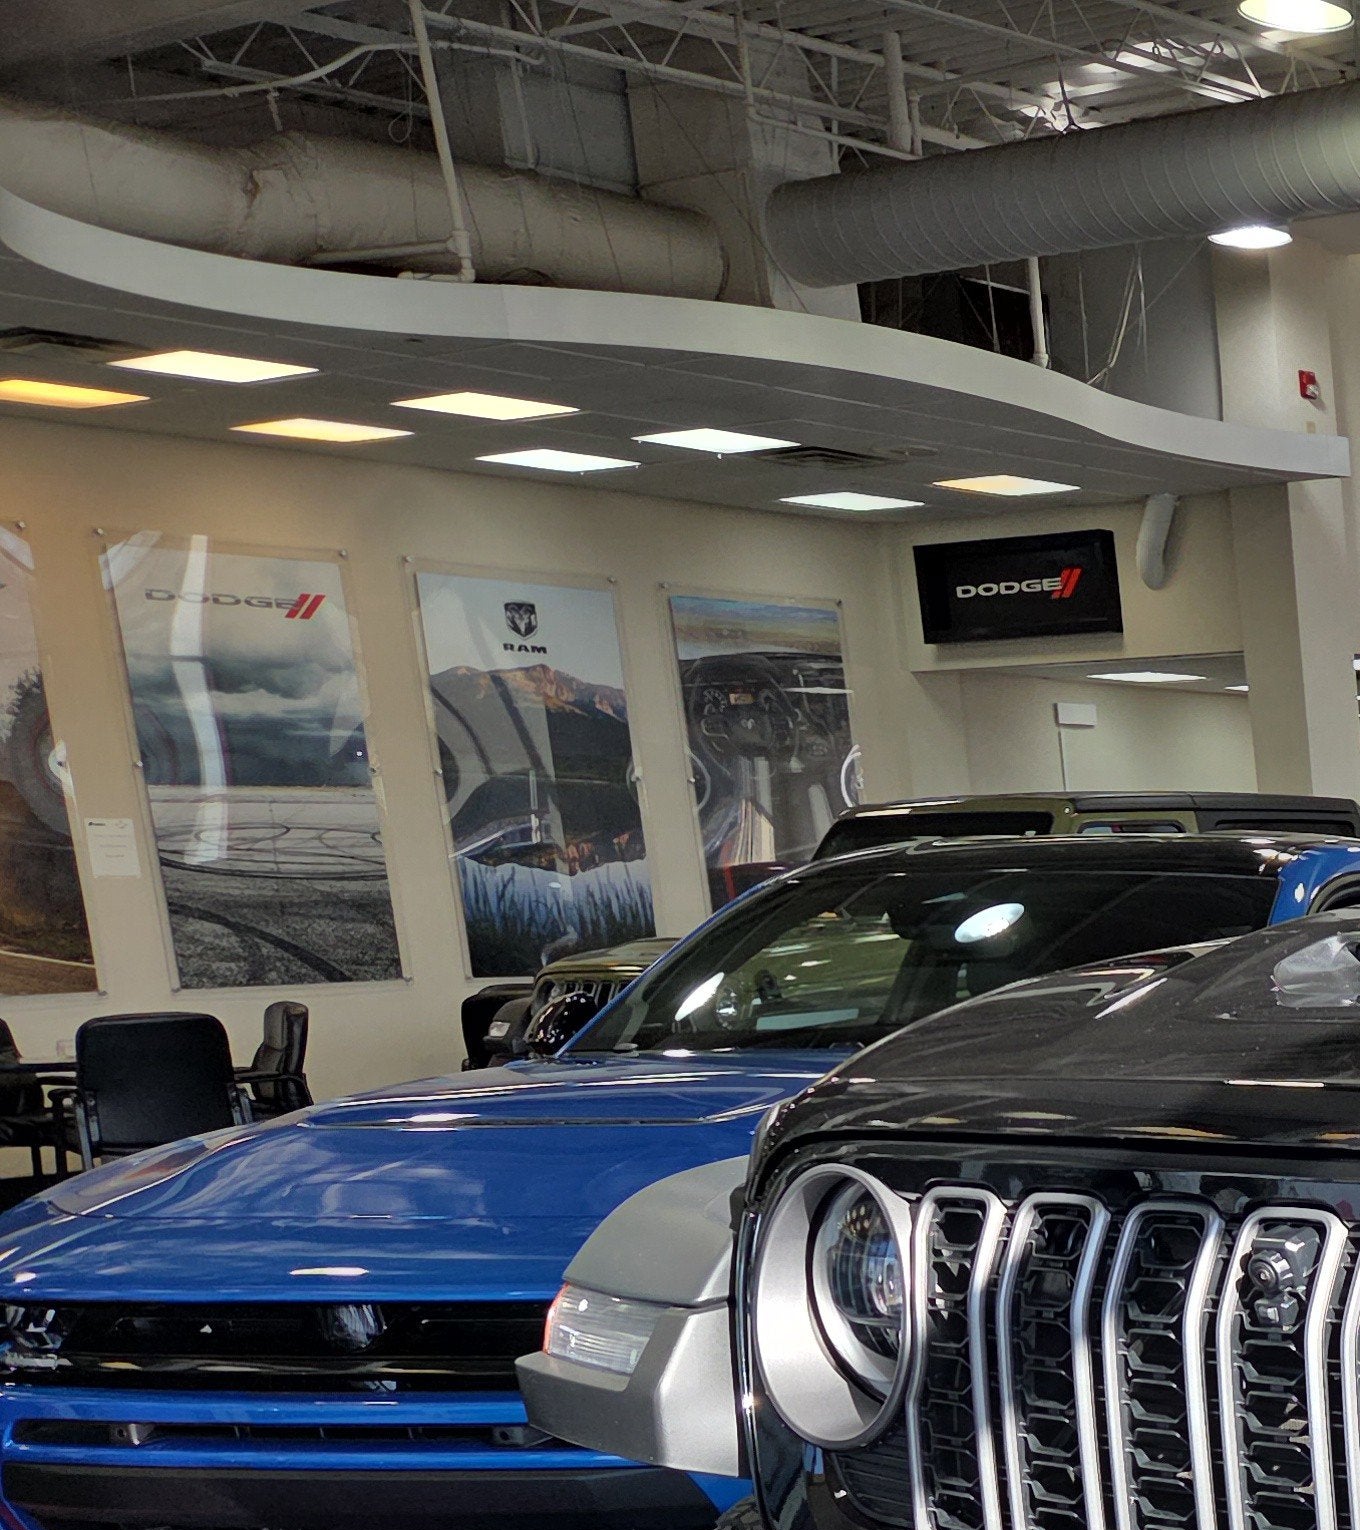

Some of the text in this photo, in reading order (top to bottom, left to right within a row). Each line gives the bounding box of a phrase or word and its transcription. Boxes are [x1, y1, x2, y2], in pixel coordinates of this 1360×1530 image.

[144, 588, 301, 610] DODGE
[955, 577, 1063, 599] DODGE
[502, 642, 548, 655] RAM
